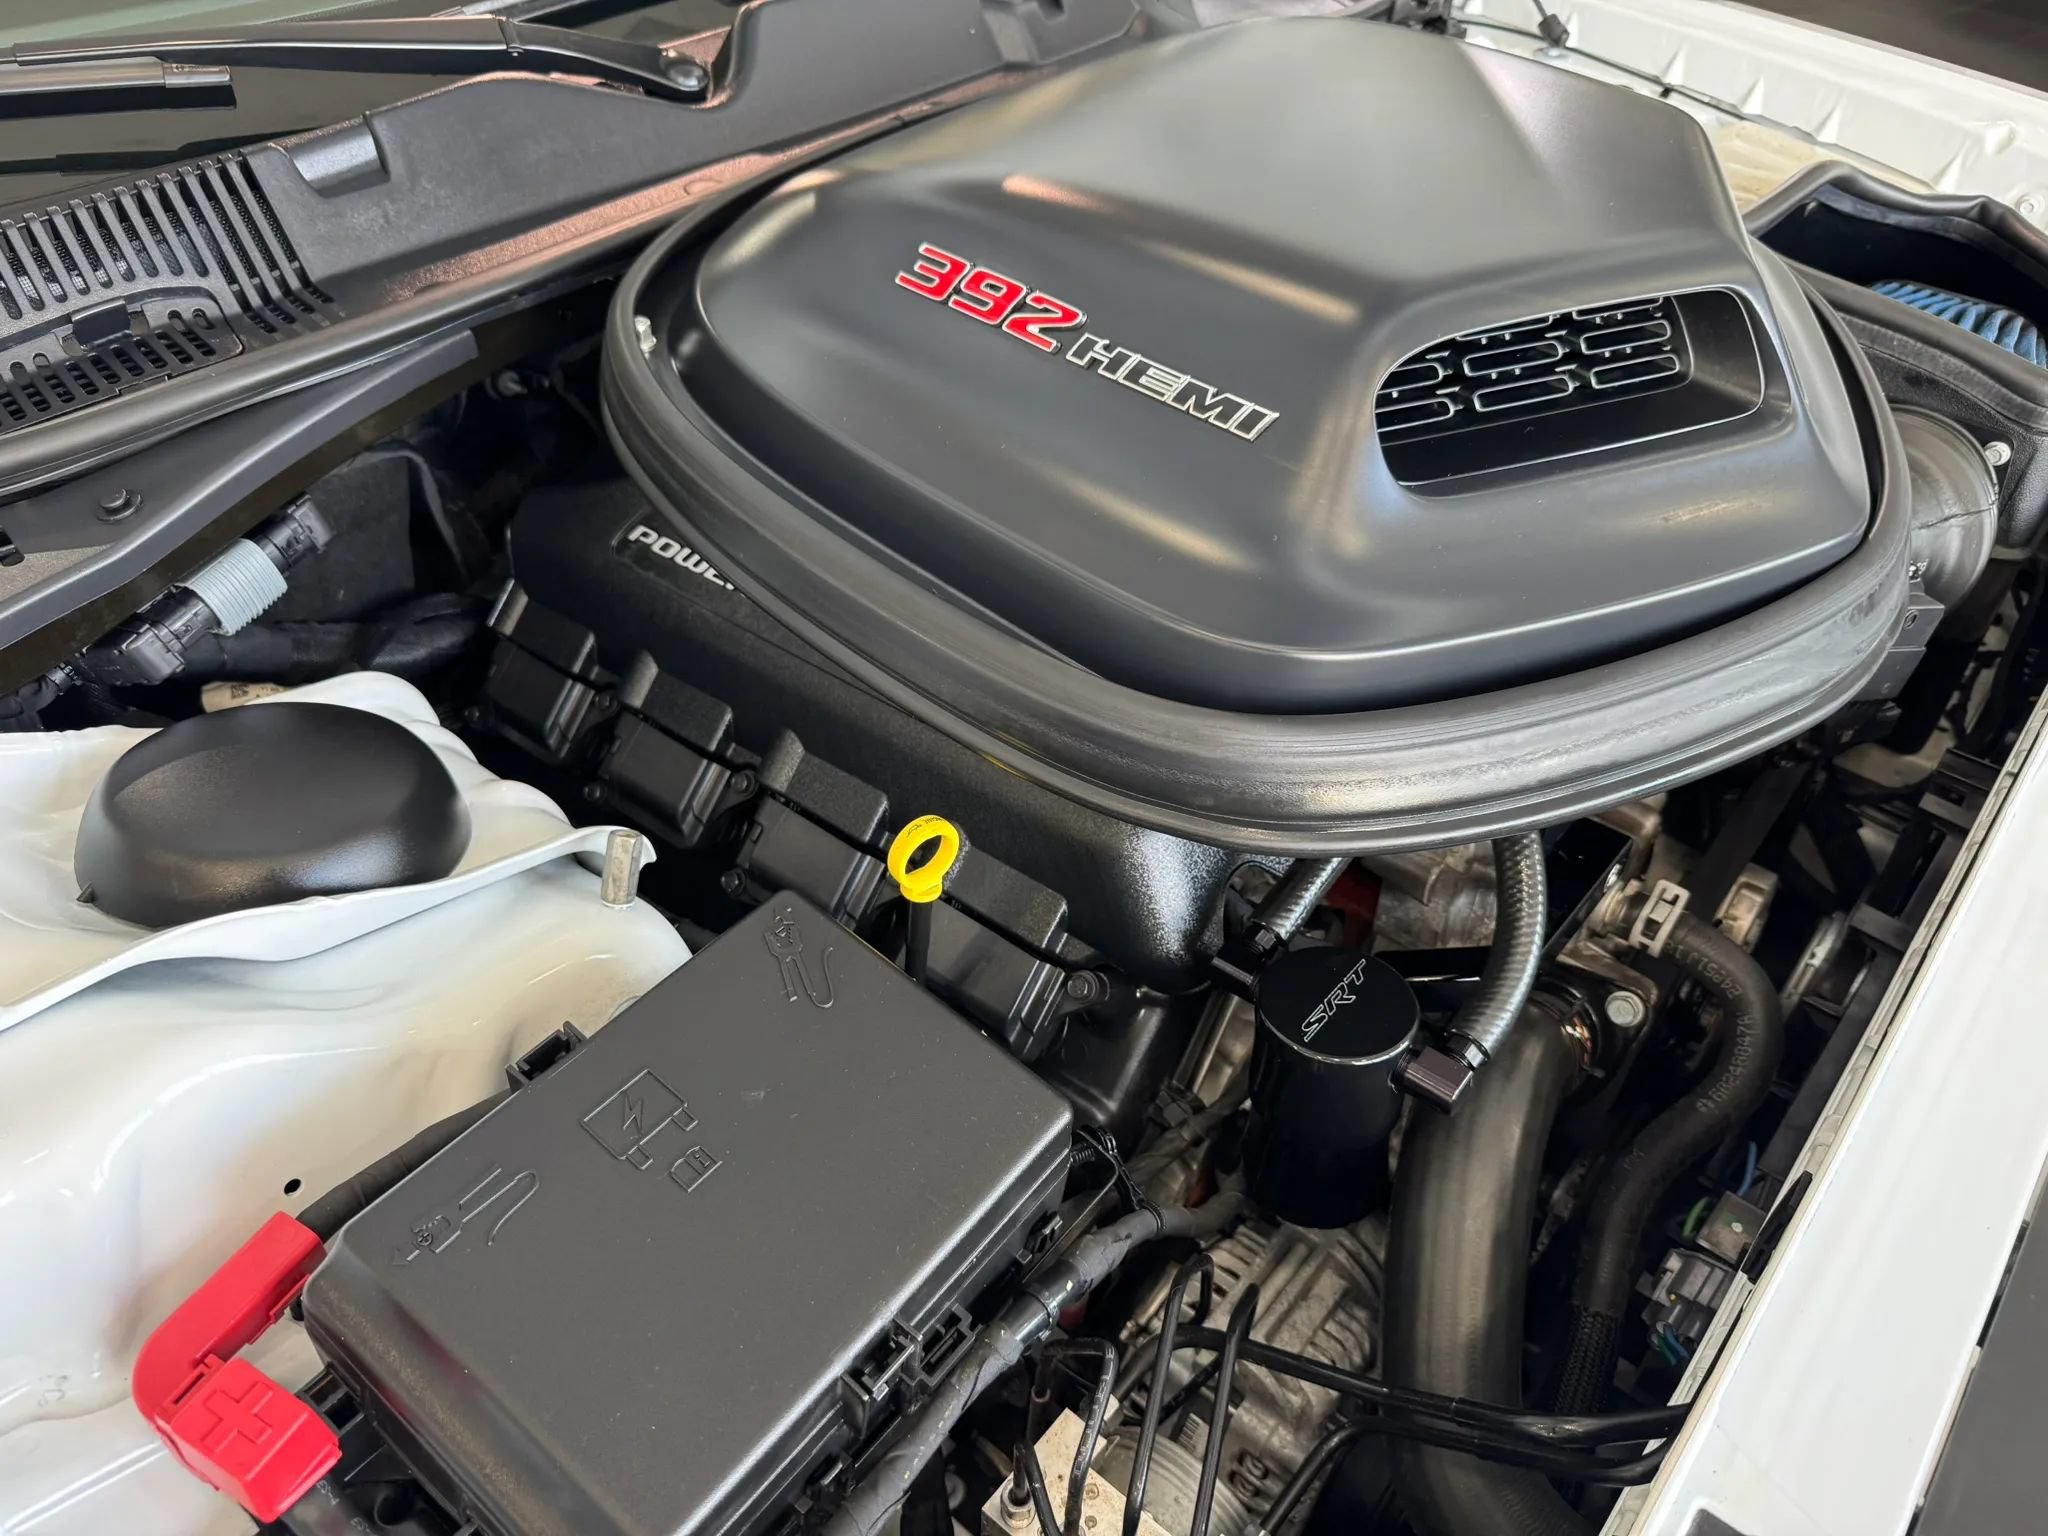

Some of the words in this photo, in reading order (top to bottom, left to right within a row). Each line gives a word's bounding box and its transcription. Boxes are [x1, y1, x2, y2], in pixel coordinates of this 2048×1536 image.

[895, 242, 1087, 354] 392
[1065, 332, 1281, 443] HEMI
[1301, 958, 1367, 1043] SRT
